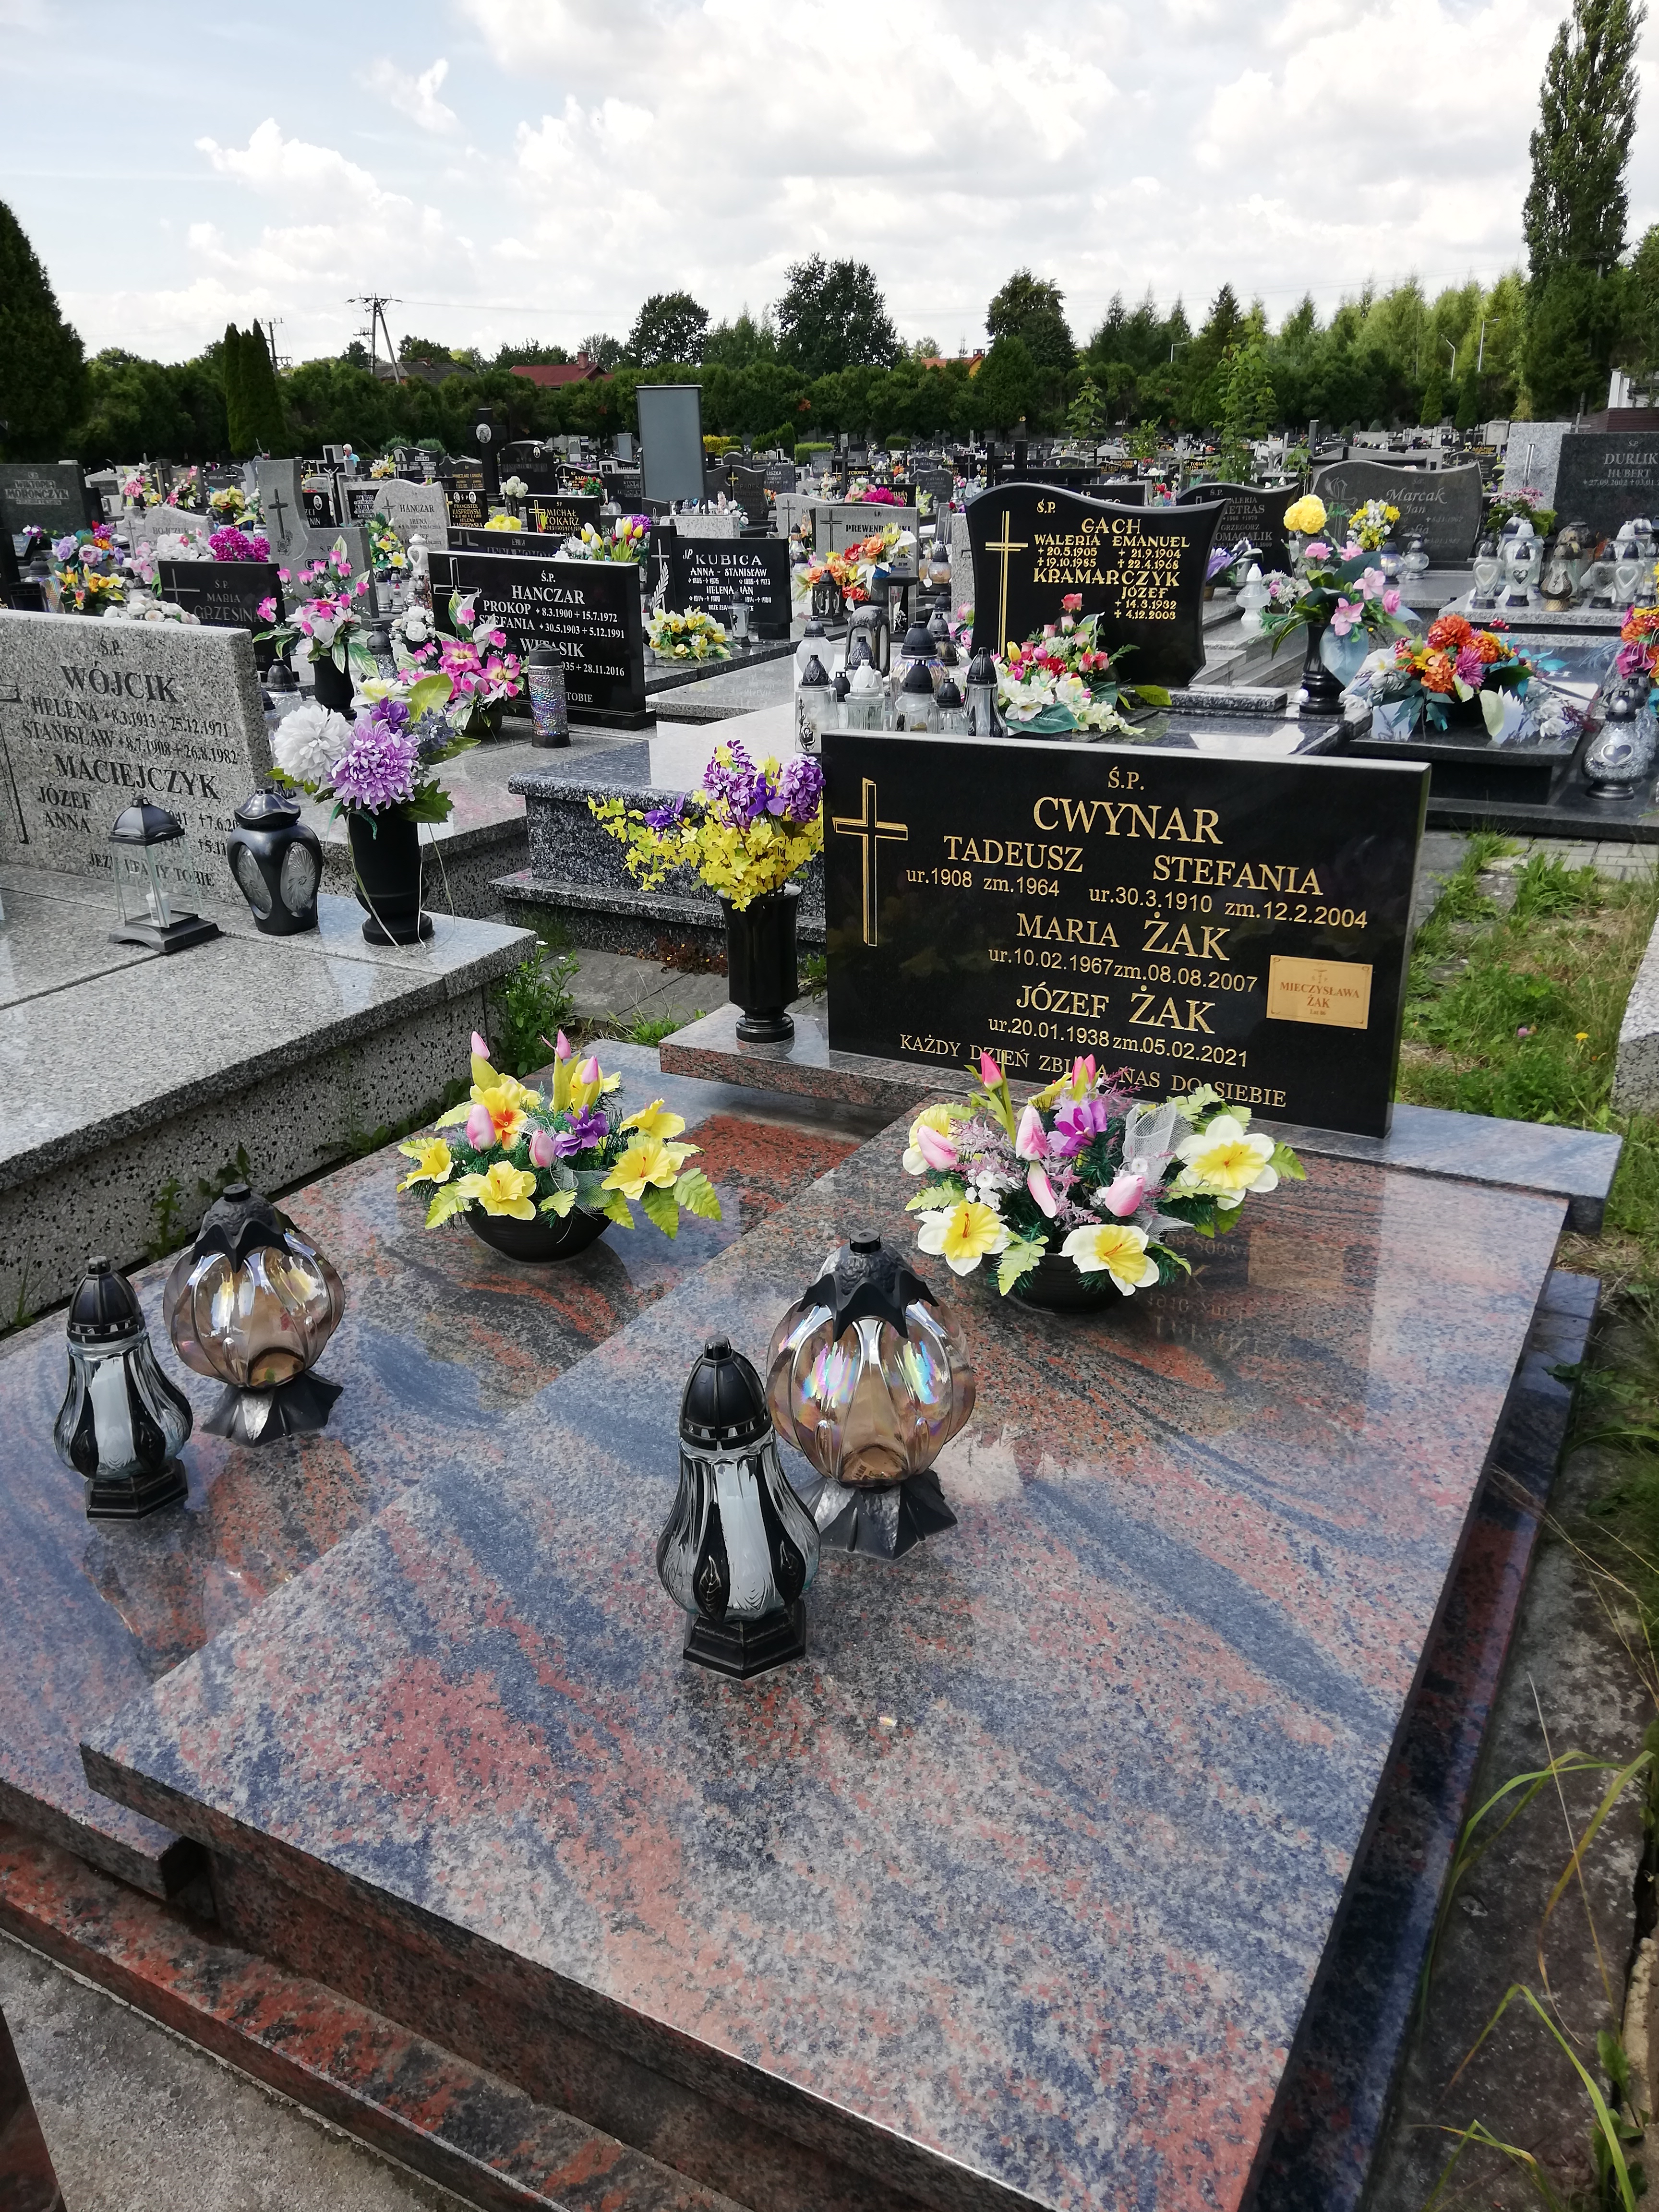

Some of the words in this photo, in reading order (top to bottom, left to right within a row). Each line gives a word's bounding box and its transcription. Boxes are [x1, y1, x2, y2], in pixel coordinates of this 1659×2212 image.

[1604, 453, 1659, 465] DURLIK
[1608, 469, 1651, 478] HUBERT
[1385, 487, 1447, 504] Marcak
[400, 504, 435, 513] HANCZAR
[546, 508, 577, 517] MICHAŁ
[1225, 505, 1265, 515] IETRAS
[1405, 504, 1426, 514] Jan
[1081, 517, 1141, 534] GACH
[1034, 533, 1101, 546] WALERIA
[1112, 534, 1190, 548] EMANUEL
[1215, 531, 1273, 541] OMAGALIK
[696, 554, 762, 565] KUBICA
[541, 570, 556, 583] Ś.P.
[690, 567, 714, 576] ANNA
[724, 568, 767, 577] STANISŁAW
[1033, 567, 1180, 587] KRAMARCZYK
[206, 593, 241, 603] MARIA
[511, 585, 585, 605] HANCZAR
[706, 585, 734, 595] HELENA
[1121, 585, 1168, 600] JÓZEF
[194, 605, 264, 623] GRZESINA
[483, 600, 531, 614] PROKOP
[541, 607, 573, 619] 8.3.1900
[582, 611, 618, 623] 15.7.1972
[479, 614, 535, 631] STEFANIA
[545, 623, 580, 635] 30.5.1903
[589, 626, 625, 639] 5.12.1991
[583, 663, 625, 676] 28.11.2016
[60, 661, 180, 703] WÓJCIK
[565, 692, 593, 703] TOBIE
[30, 696, 99, 722] HELENA
[111, 709, 156, 729] 8.3.1913
[170, 716, 228, 737] 25.12.1971
[22, 721, 114, 748] STANISŁAW
[184, 744, 239, 765] 26.8.1982
[53, 754, 221, 800] MACIEJCZYK
[1107, 766, 1145, 790] Ś.P.
[38, 782, 91, 810] JÓZEF
[45, 810, 92, 833] ANNA
[1033, 796, 1224, 845] CWYNAR
[944, 835, 1083, 873] TADEUSZ
[1153, 854, 1323, 896] STEFANIA
[906, 867, 972, 888] ur.1908
[983, 876, 1060, 897] zm.1964
[1089, 887, 1213, 913] ur.30.3.1910
[1225, 901, 1368, 929] zm.12.2.2004
[1016, 913, 1120, 948] MARIA
[1142, 911, 1231, 961] ŻAK
[1280, 982, 1359, 998] MIECZYSŁAWA
[1016, 981, 1109, 1019] JÓZEF
[1129, 985, 1215, 1034] ŻAK
[1307, 994, 1330, 1008] ŻAK
[988, 1017, 1109, 1046] ur.20.01.1938
[1112, 1035, 1248, 1068] zm.05.02.2021
[900, 1034, 961, 1057] KAŻDY
[1118, 1067, 1160, 1088] NAS
[1170, 1074, 1202, 1092] DO
[1214, 1081, 1286, 1108] SIEBIE
